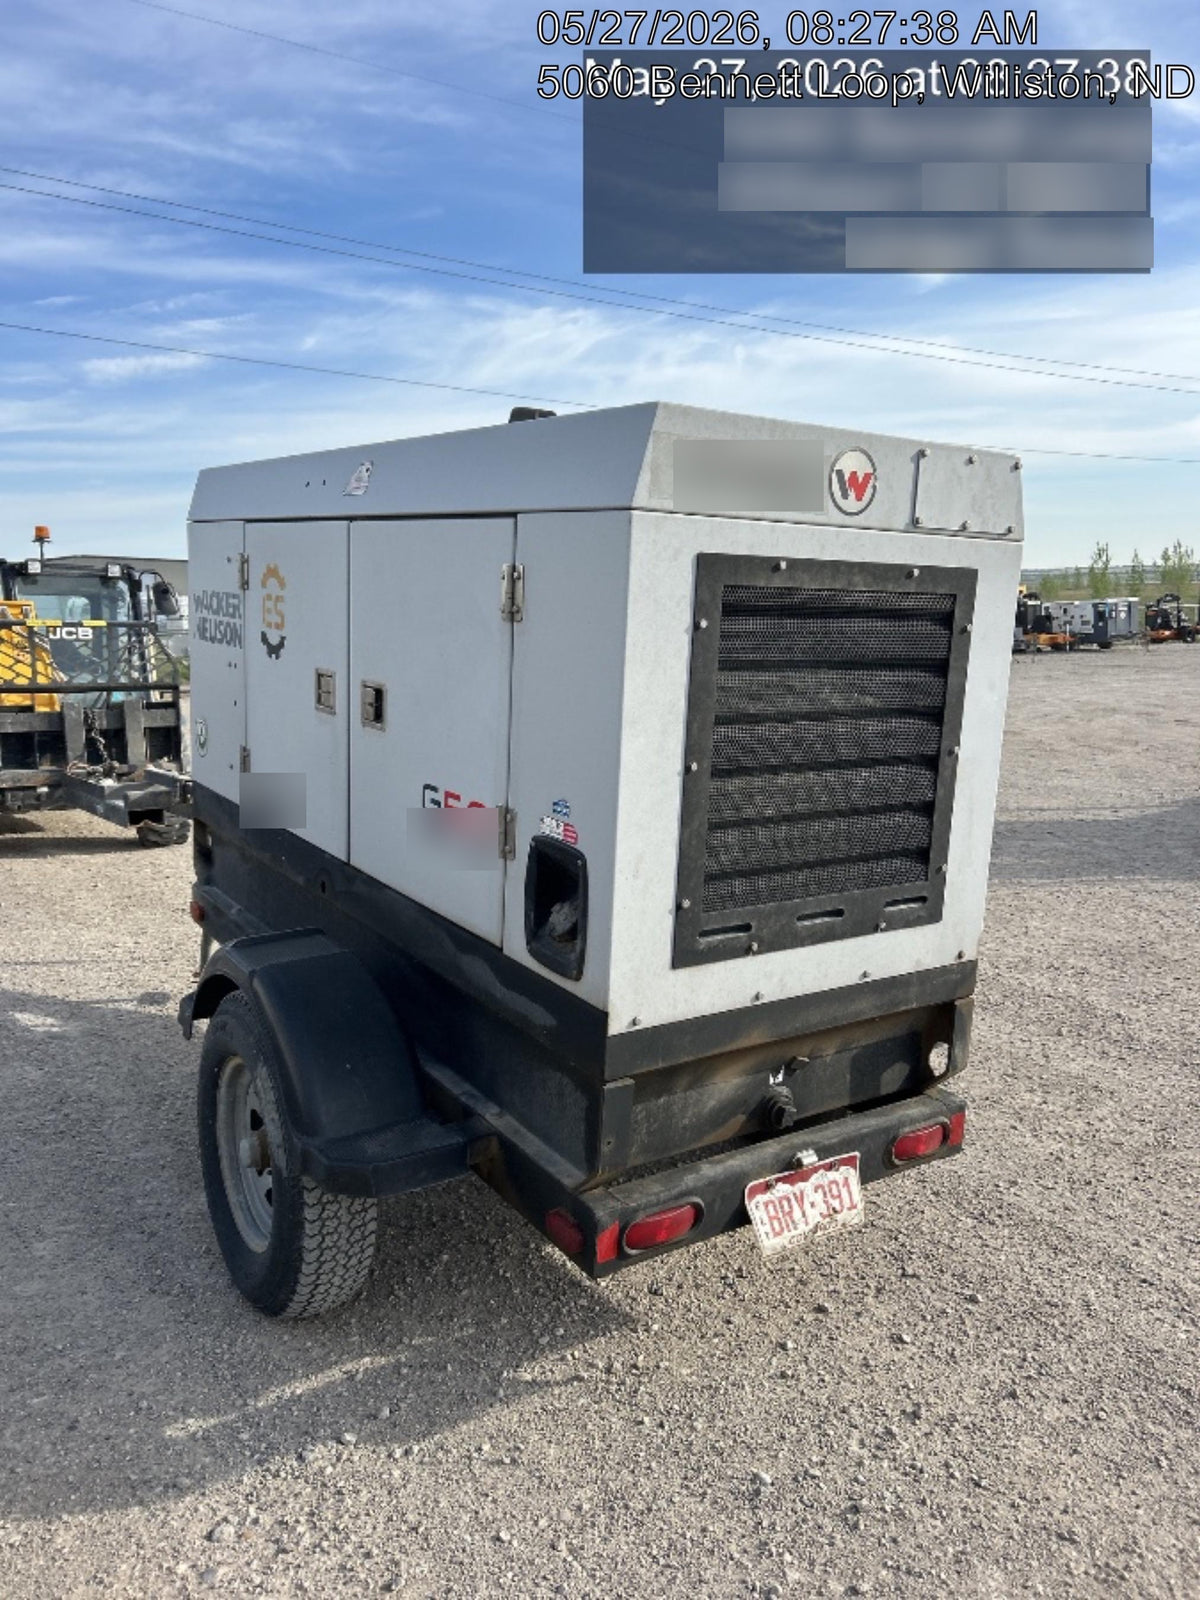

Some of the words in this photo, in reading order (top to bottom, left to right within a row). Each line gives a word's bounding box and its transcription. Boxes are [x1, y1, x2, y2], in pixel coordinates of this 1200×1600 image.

[193, 589, 242, 620] WACKER
[262, 593, 285, 631] ES
[48, 626, 93, 639] JCB
